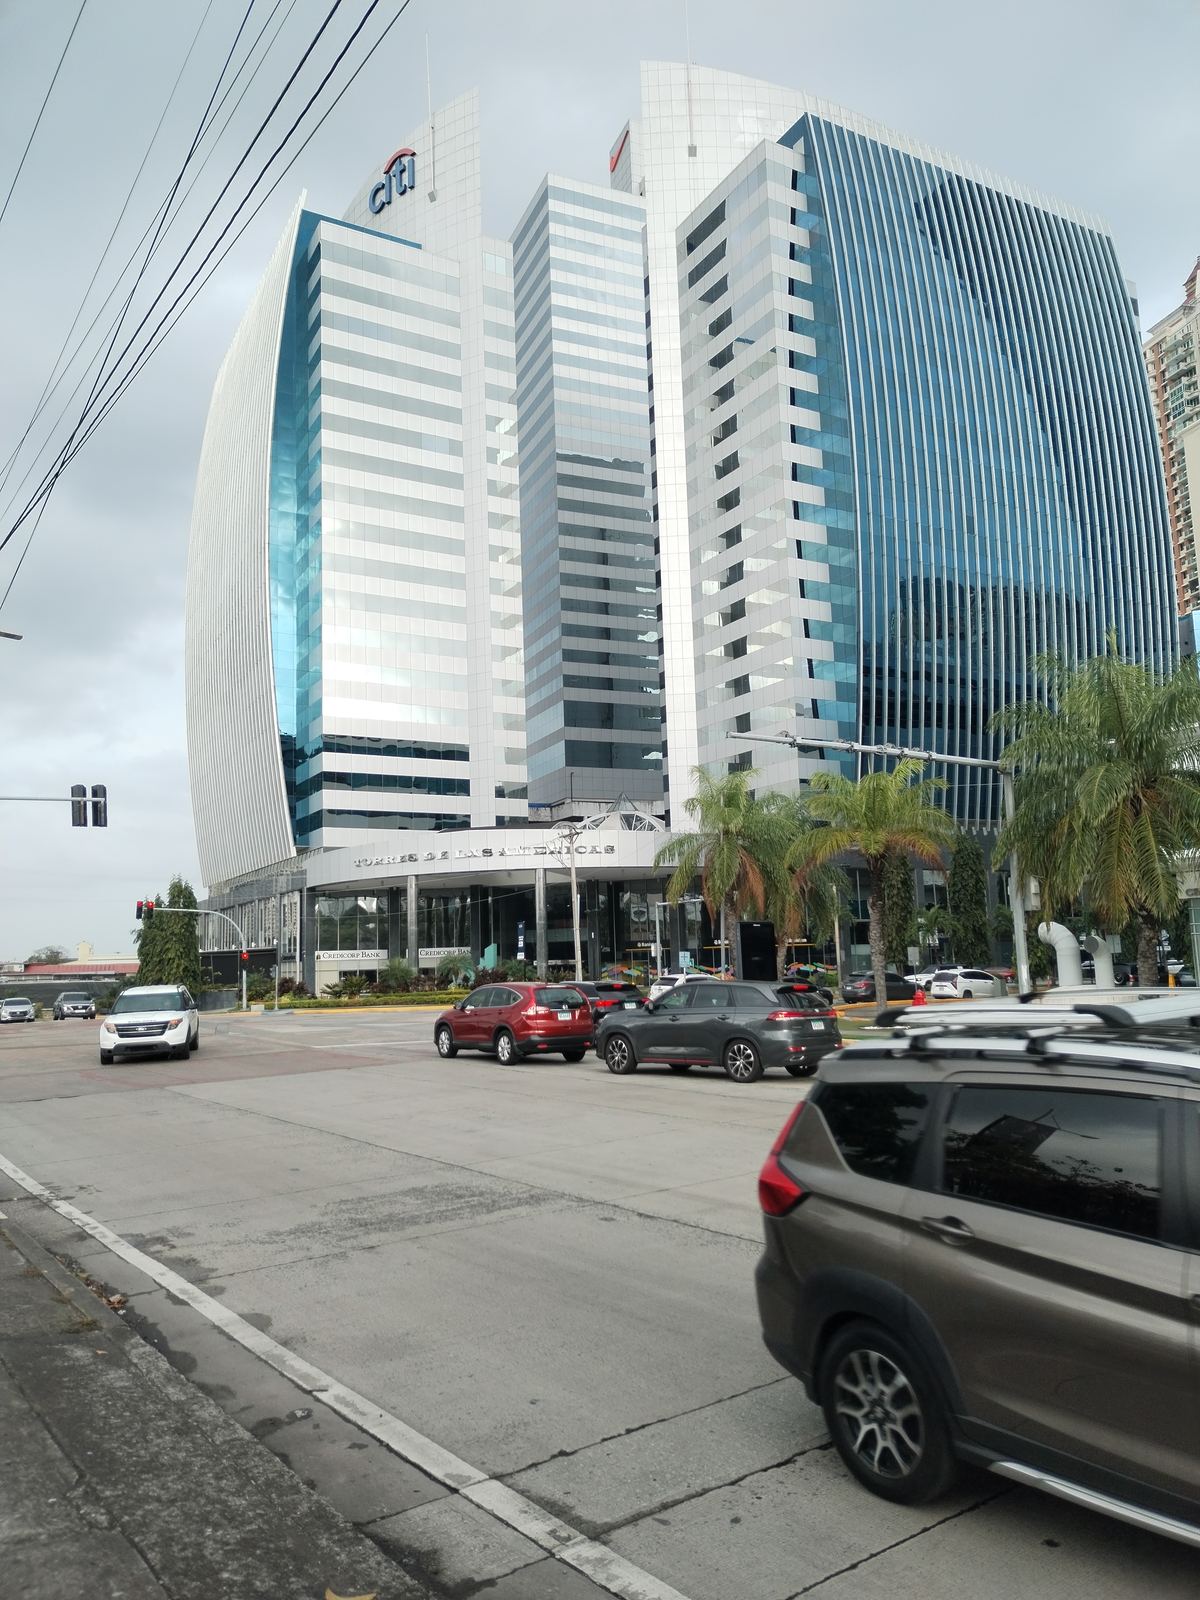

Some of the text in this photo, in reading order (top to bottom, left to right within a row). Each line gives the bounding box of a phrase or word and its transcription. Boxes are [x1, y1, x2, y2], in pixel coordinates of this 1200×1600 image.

[368, 155, 416, 214] citi
[353, 853, 418, 868] TORRES
[423, 850, 449, 861] DE
[454, 848, 494, 860] LAS
